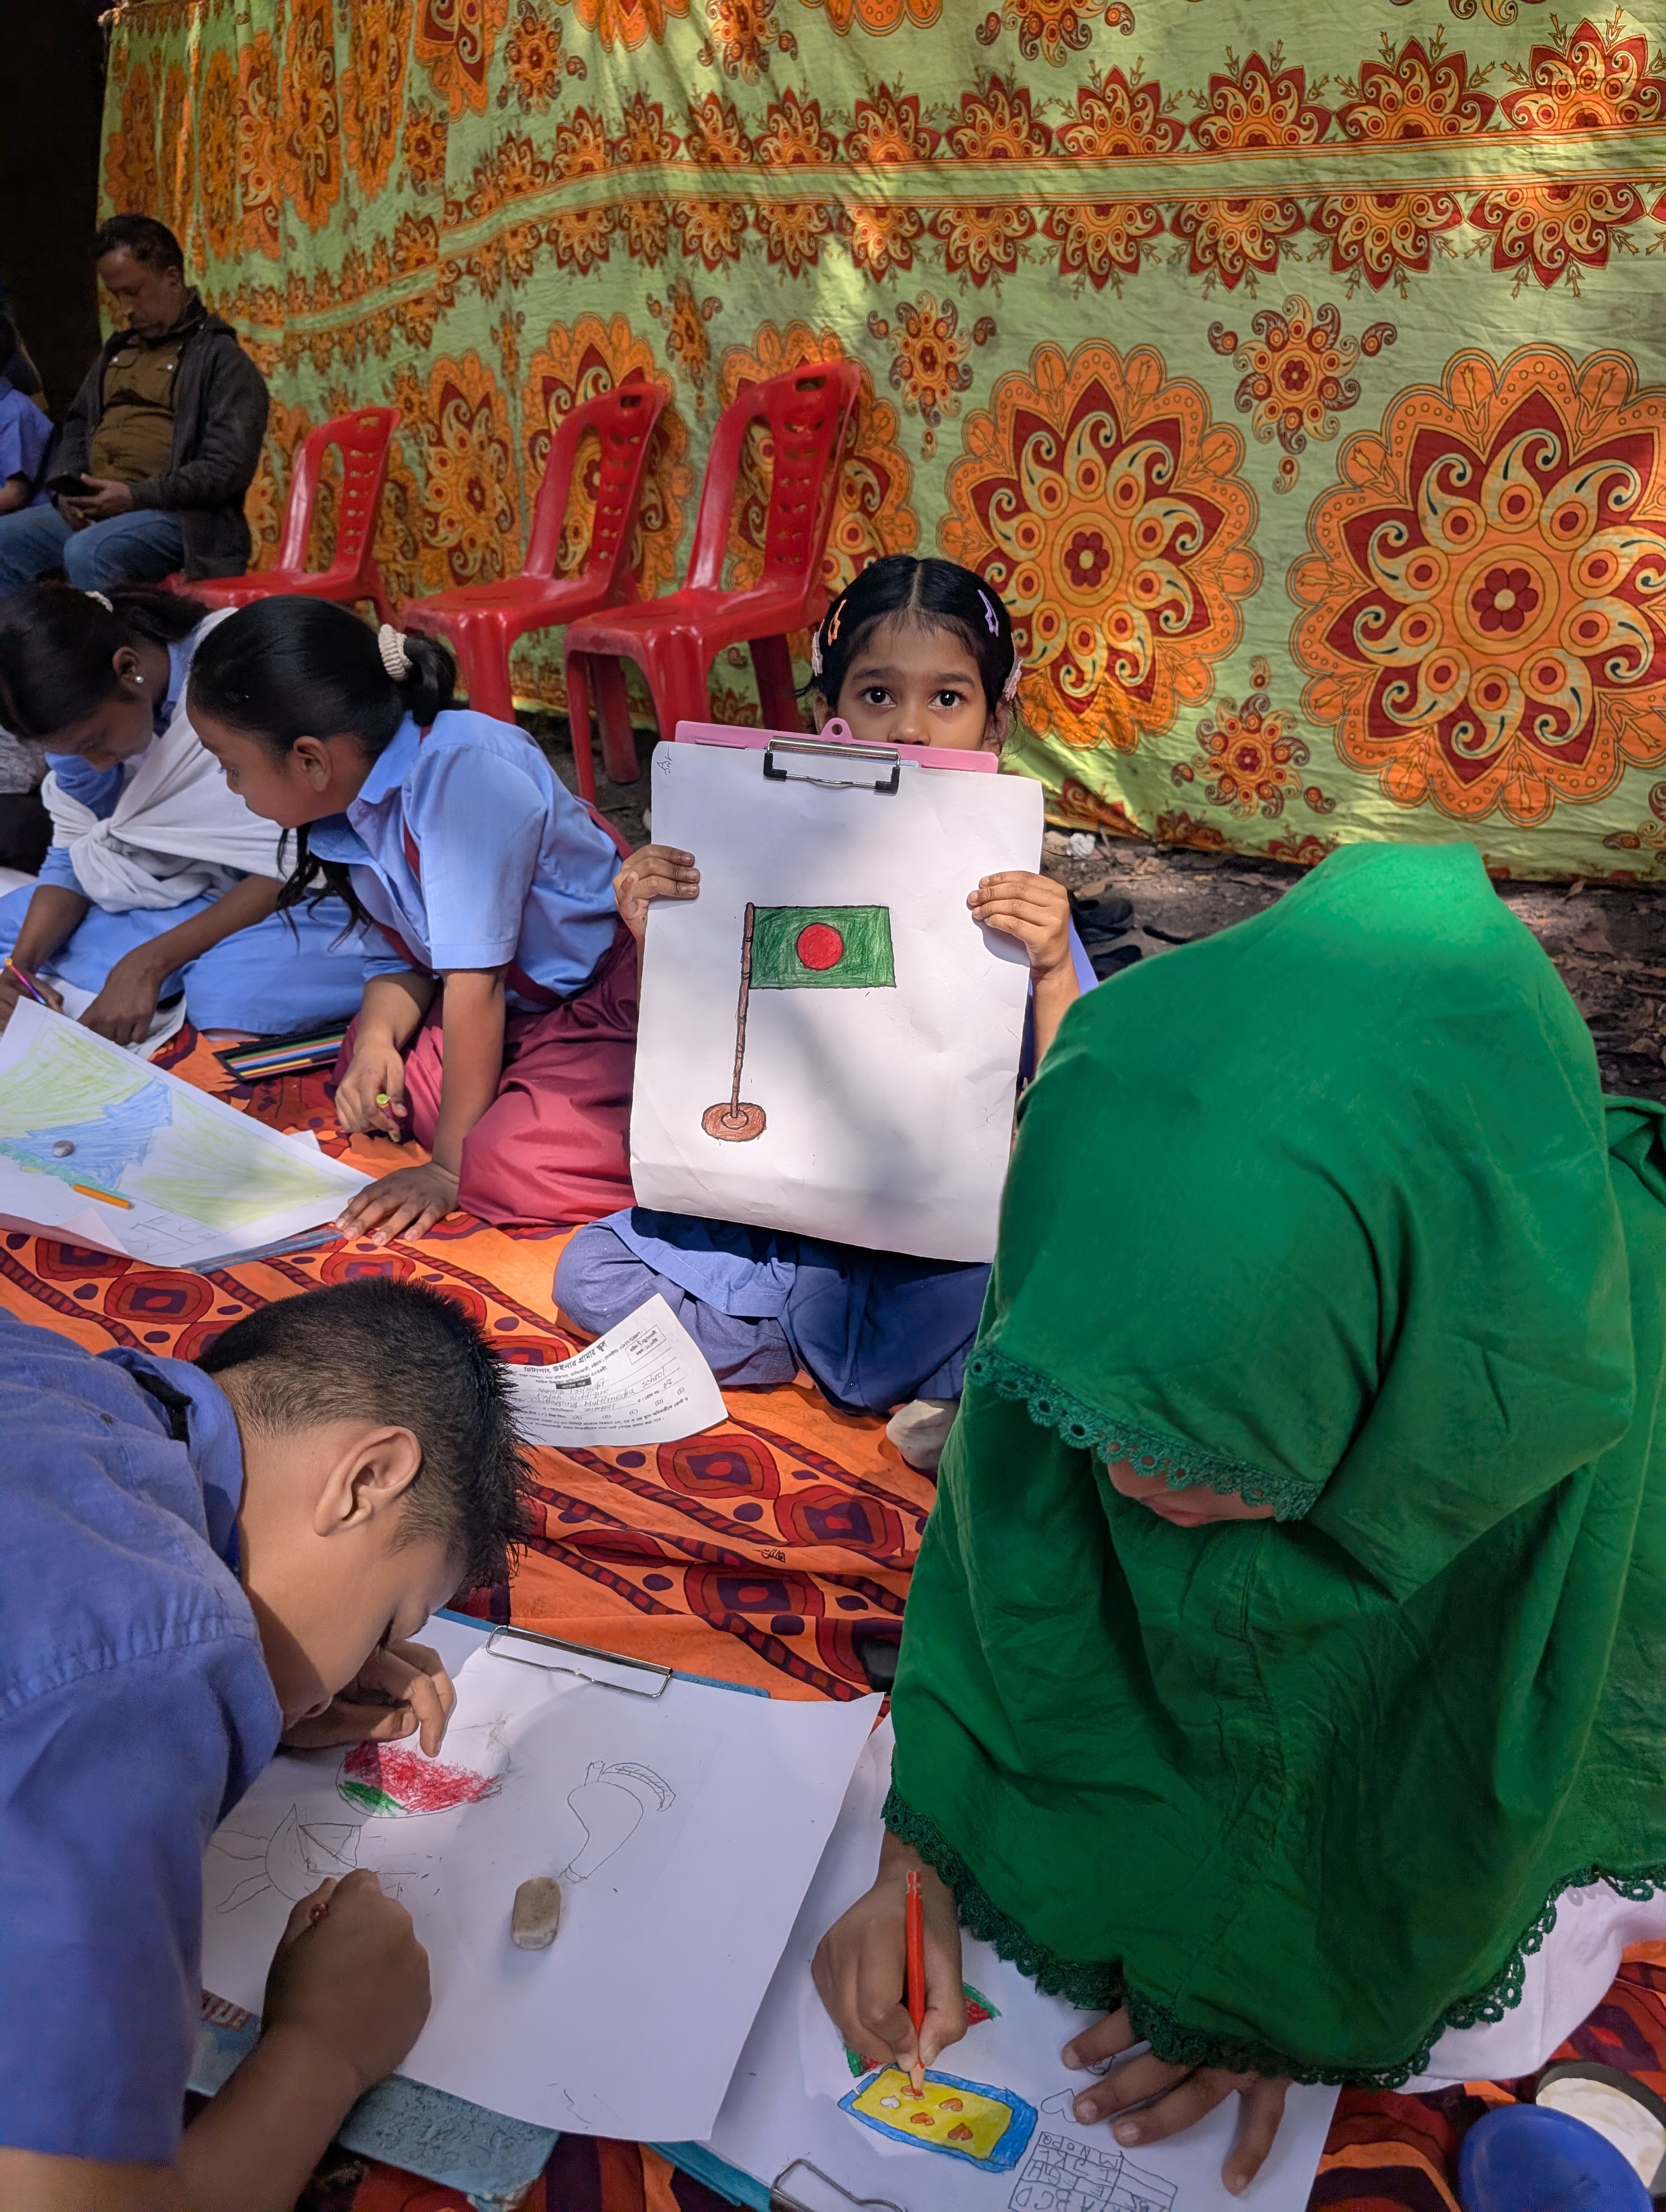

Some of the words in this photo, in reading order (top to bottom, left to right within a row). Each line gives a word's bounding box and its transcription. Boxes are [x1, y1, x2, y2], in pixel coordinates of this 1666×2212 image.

[553, 1360, 576, 1372] উইনার
[578, 1349, 597, 1364] গ্রামার
[595, 1340, 608, 1354] স্কুল
[655, 1398, 664, 1406] (D)
[677, 1386, 685, 1395] (E)
